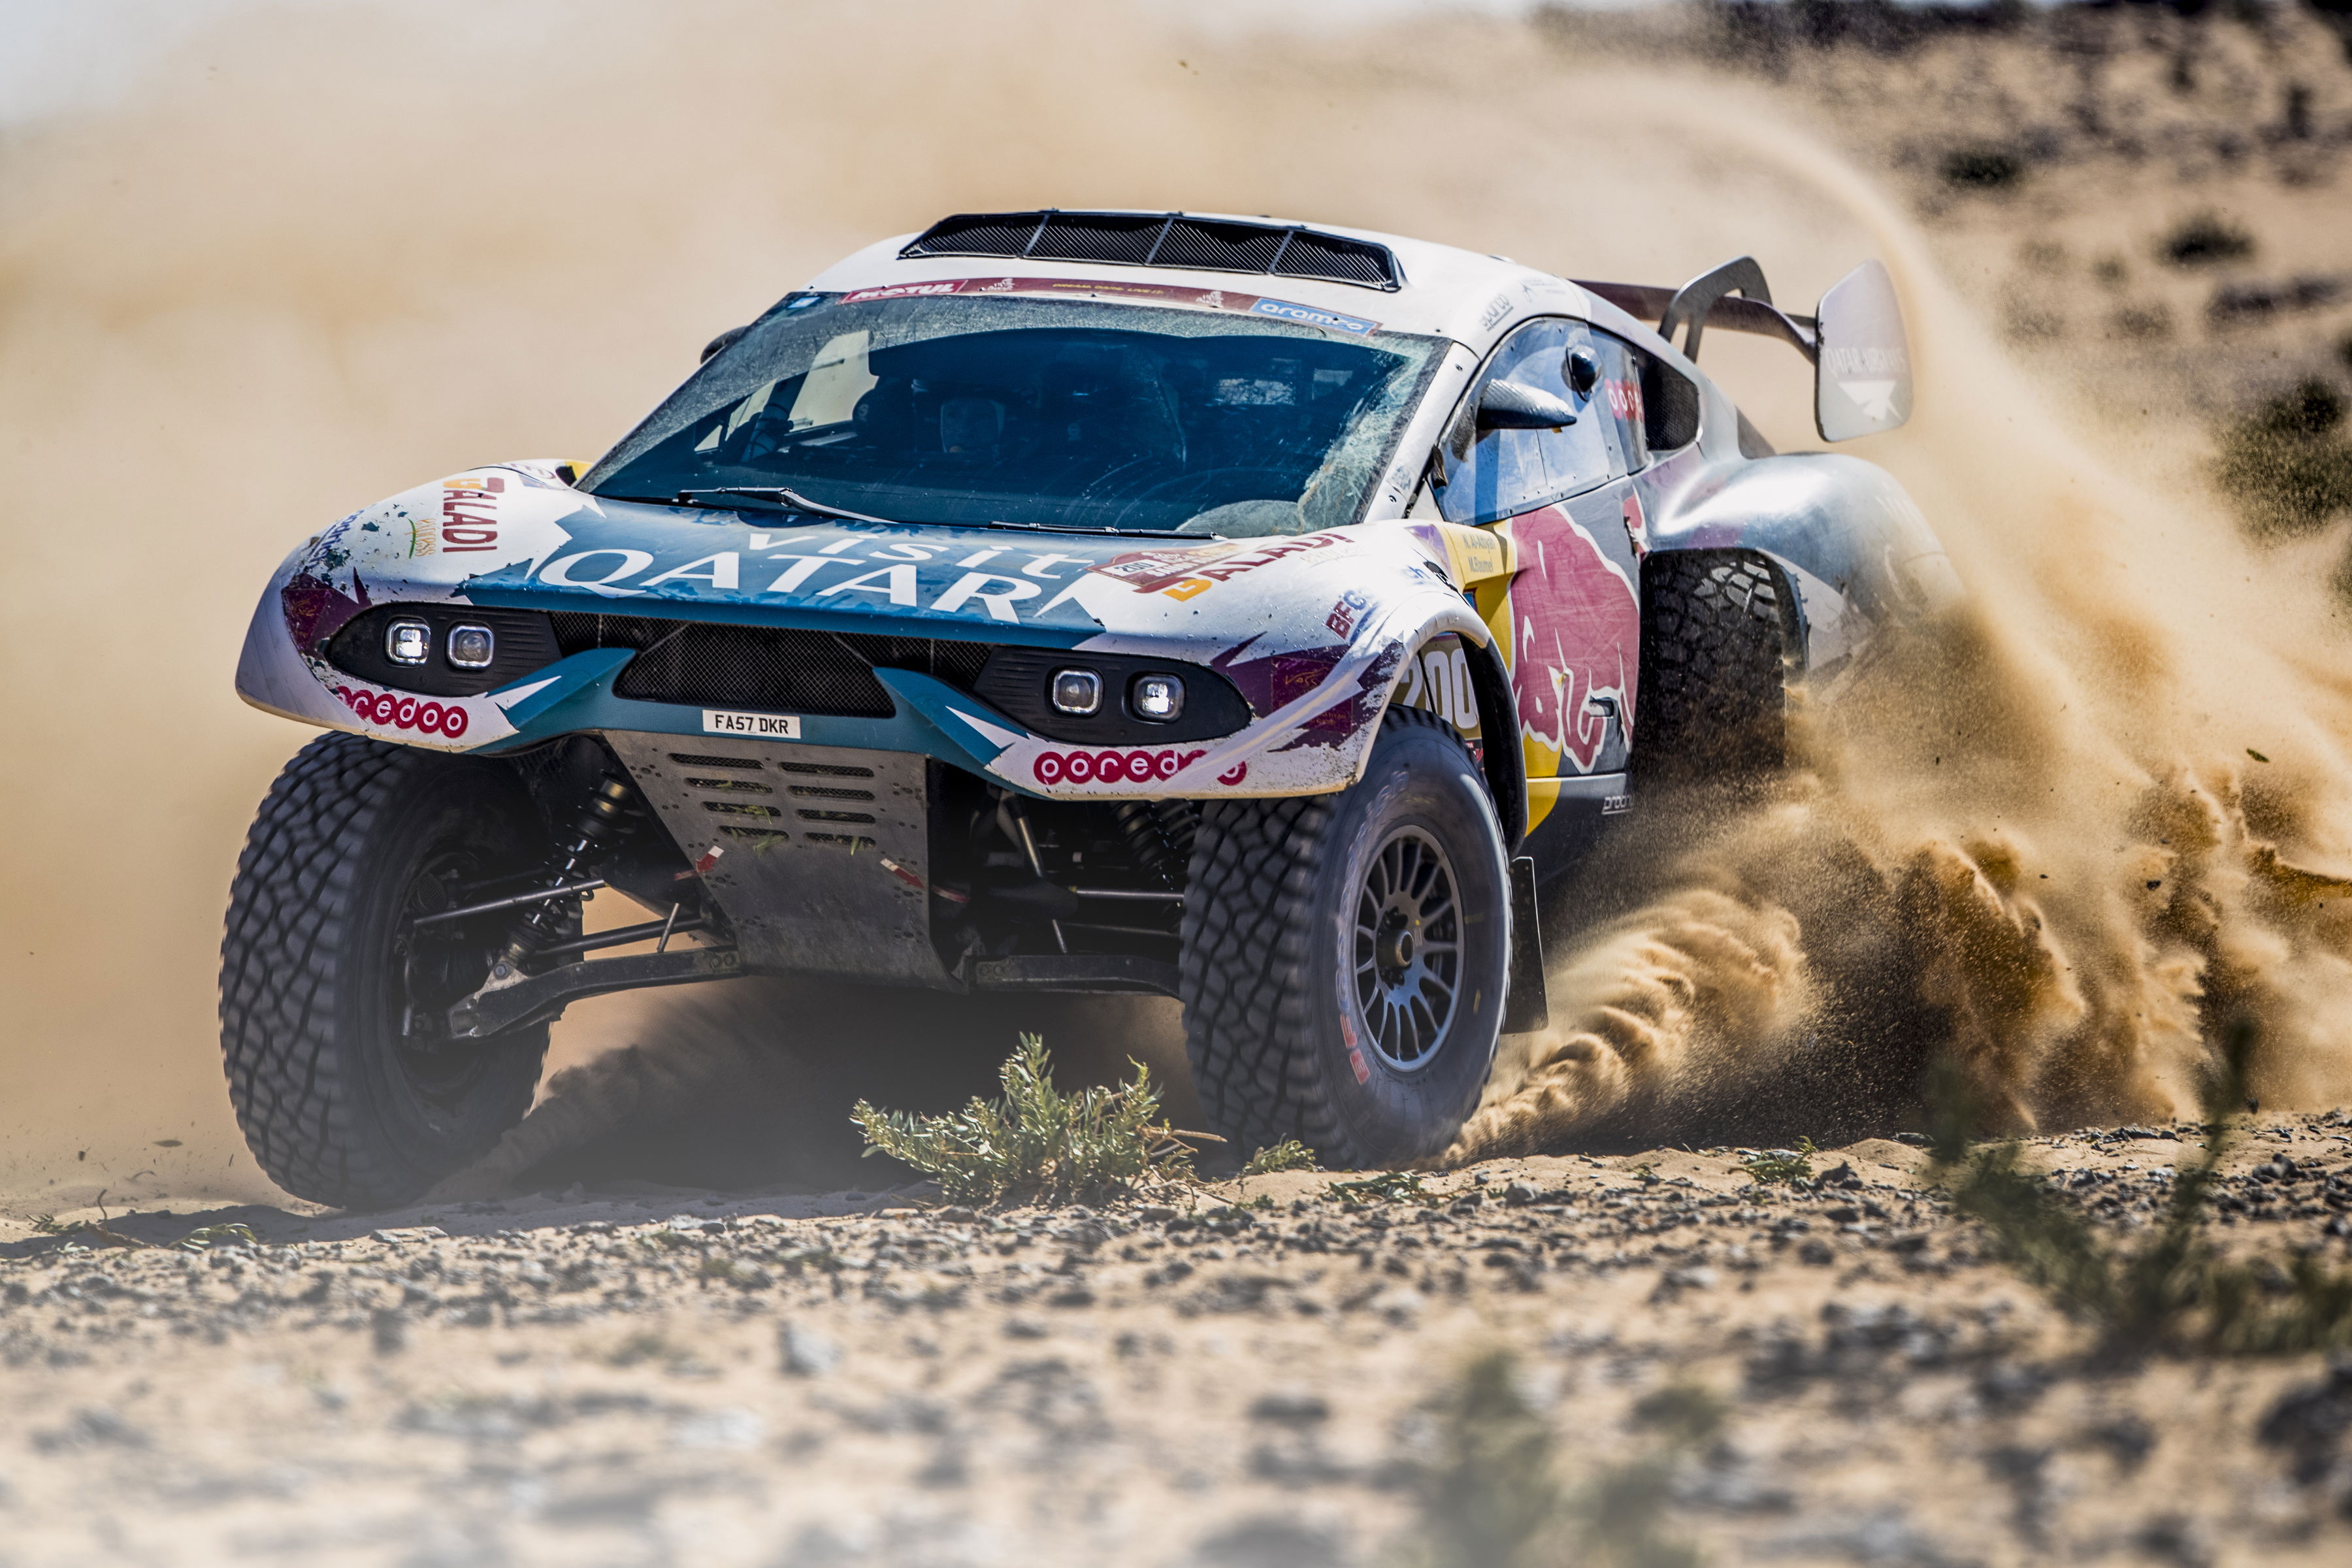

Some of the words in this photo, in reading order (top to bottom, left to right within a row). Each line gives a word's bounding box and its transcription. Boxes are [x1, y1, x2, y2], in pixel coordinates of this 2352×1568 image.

[851, 283, 954, 300] MOTUL
[1260, 302, 1364, 331] aramco
[539, 549, 1043, 624] QATAR
[715, 714, 754, 731] FA57
[759, 717, 789, 734] DKR
